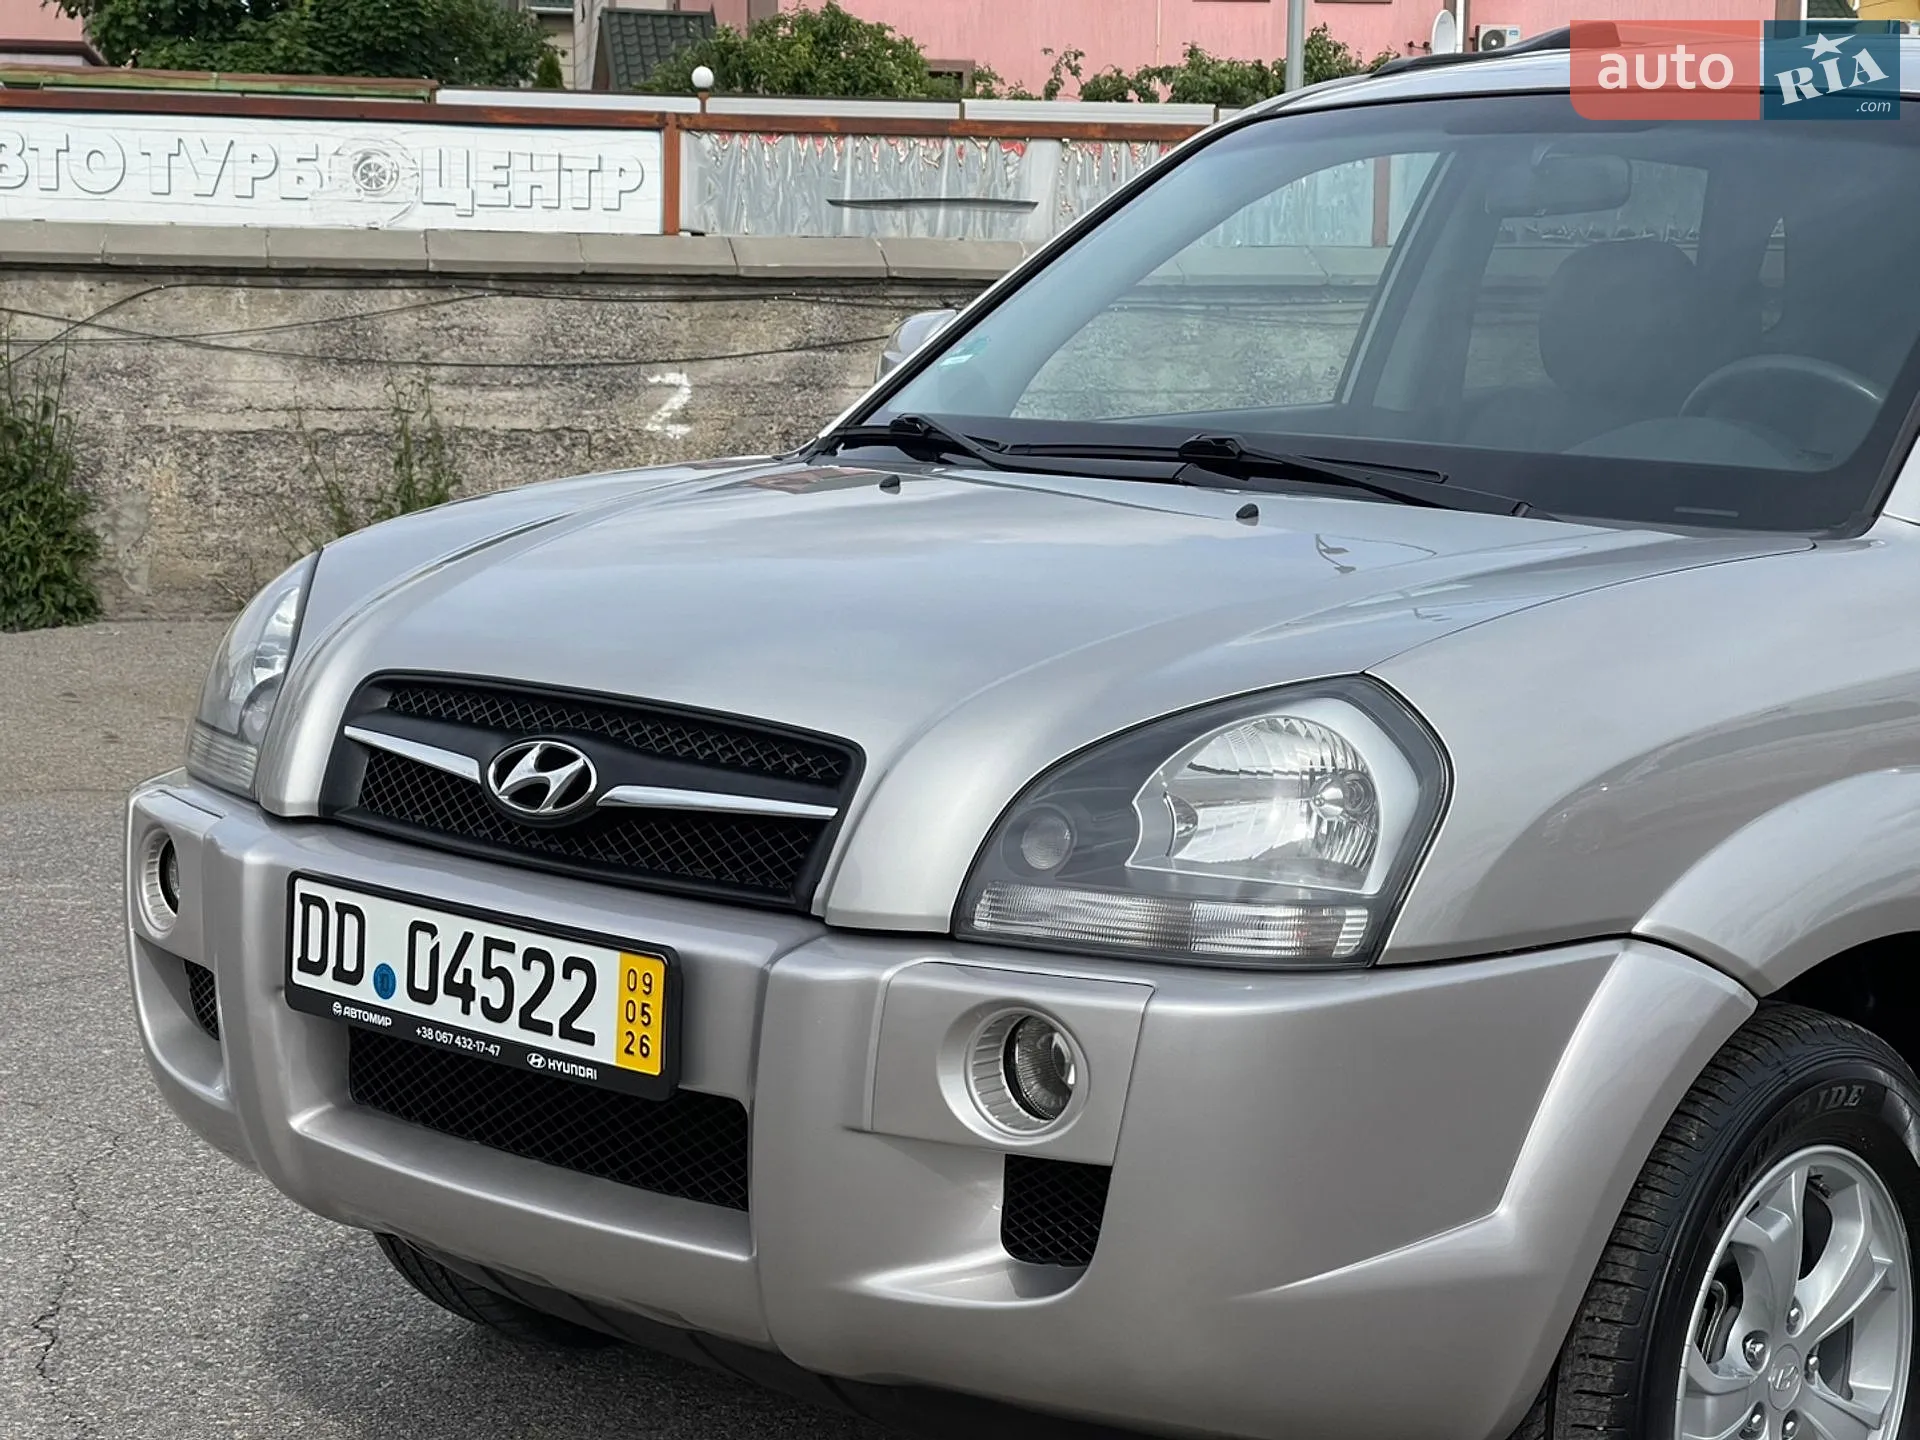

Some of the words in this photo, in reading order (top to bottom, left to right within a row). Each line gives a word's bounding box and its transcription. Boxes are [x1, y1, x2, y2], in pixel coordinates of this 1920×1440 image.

[421, 148, 645, 217] ЦЕНТР
[297, 893, 366, 986] DD
[406, 920, 597, 1046] 04522
[626, 968, 653, 996] 09
[343, 1006, 392, 1028] АВТОМИР
[625, 1000, 652, 1026] 05
[416, 1026, 434, 1040] +38
[435, 1030, 453, 1045] 067
[455, 1036, 501, 1057] 432-17-47
[624, 1030, 651, 1058] 26
[548, 1058, 598, 1080] HYUNDAI
